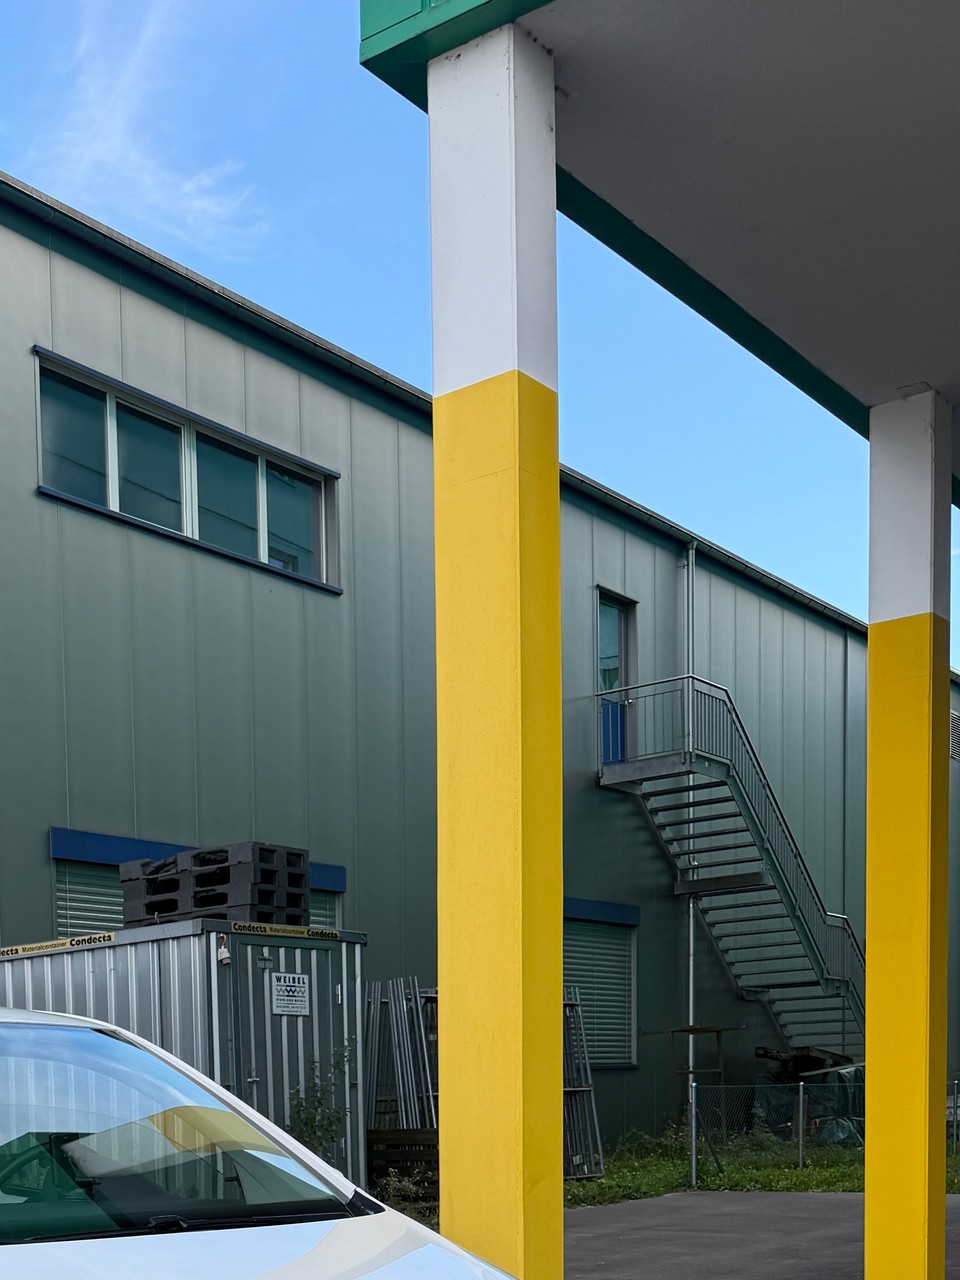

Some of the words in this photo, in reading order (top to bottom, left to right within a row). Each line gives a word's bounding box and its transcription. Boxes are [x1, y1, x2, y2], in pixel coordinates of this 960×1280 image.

[233, 922, 267, 933] Condecta
[307, 929, 339, 939] Condecta
[21, 941, 67, 953] Materialcontainer
[69, 934, 112, 947] Condecta
[275, 975, 306, 985] WEIBEL
